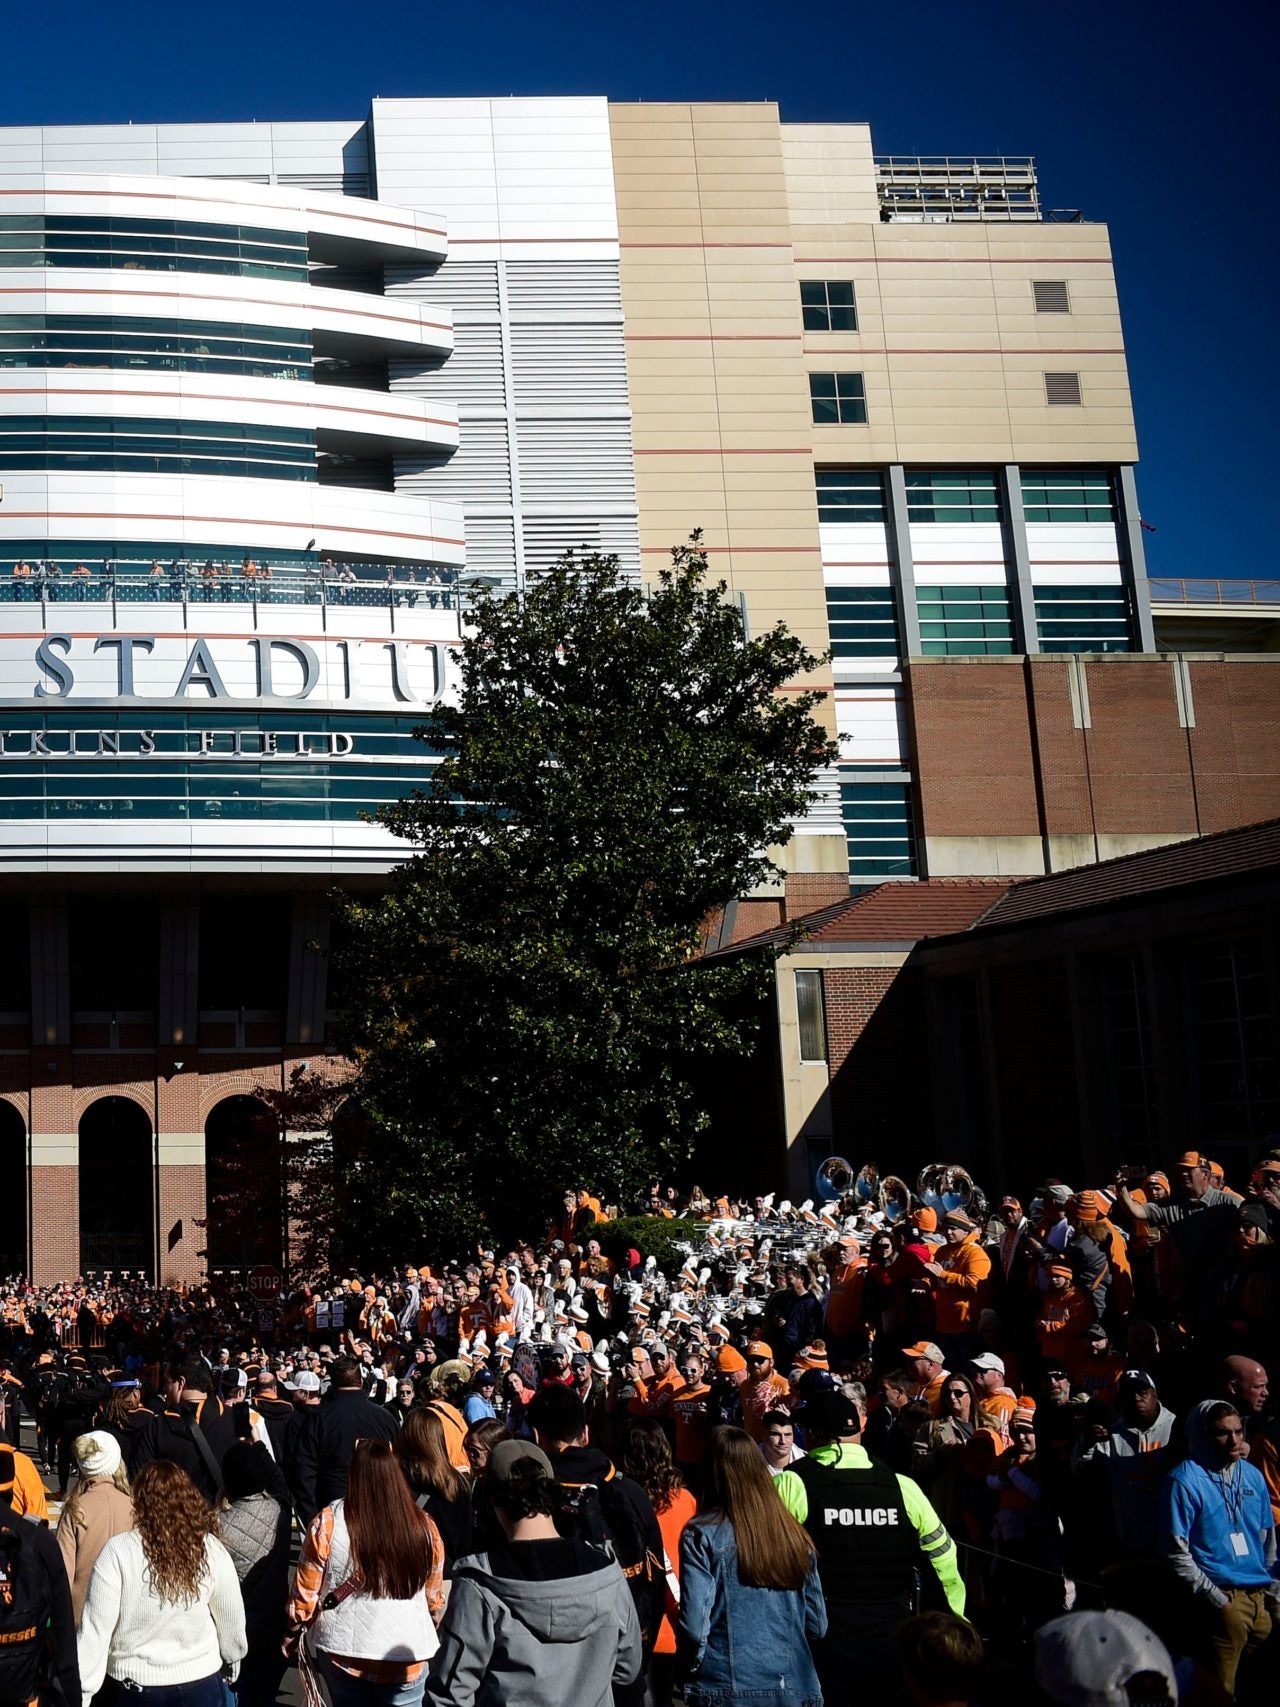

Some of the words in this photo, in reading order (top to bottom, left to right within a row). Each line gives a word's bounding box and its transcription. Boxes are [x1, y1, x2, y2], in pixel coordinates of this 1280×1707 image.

[34, 634, 452, 702] STADIU
[199, 730, 354, 757] FIELD
[249, 1275, 279, 1289] STOP
[824, 1508, 899, 1526] POLICE
